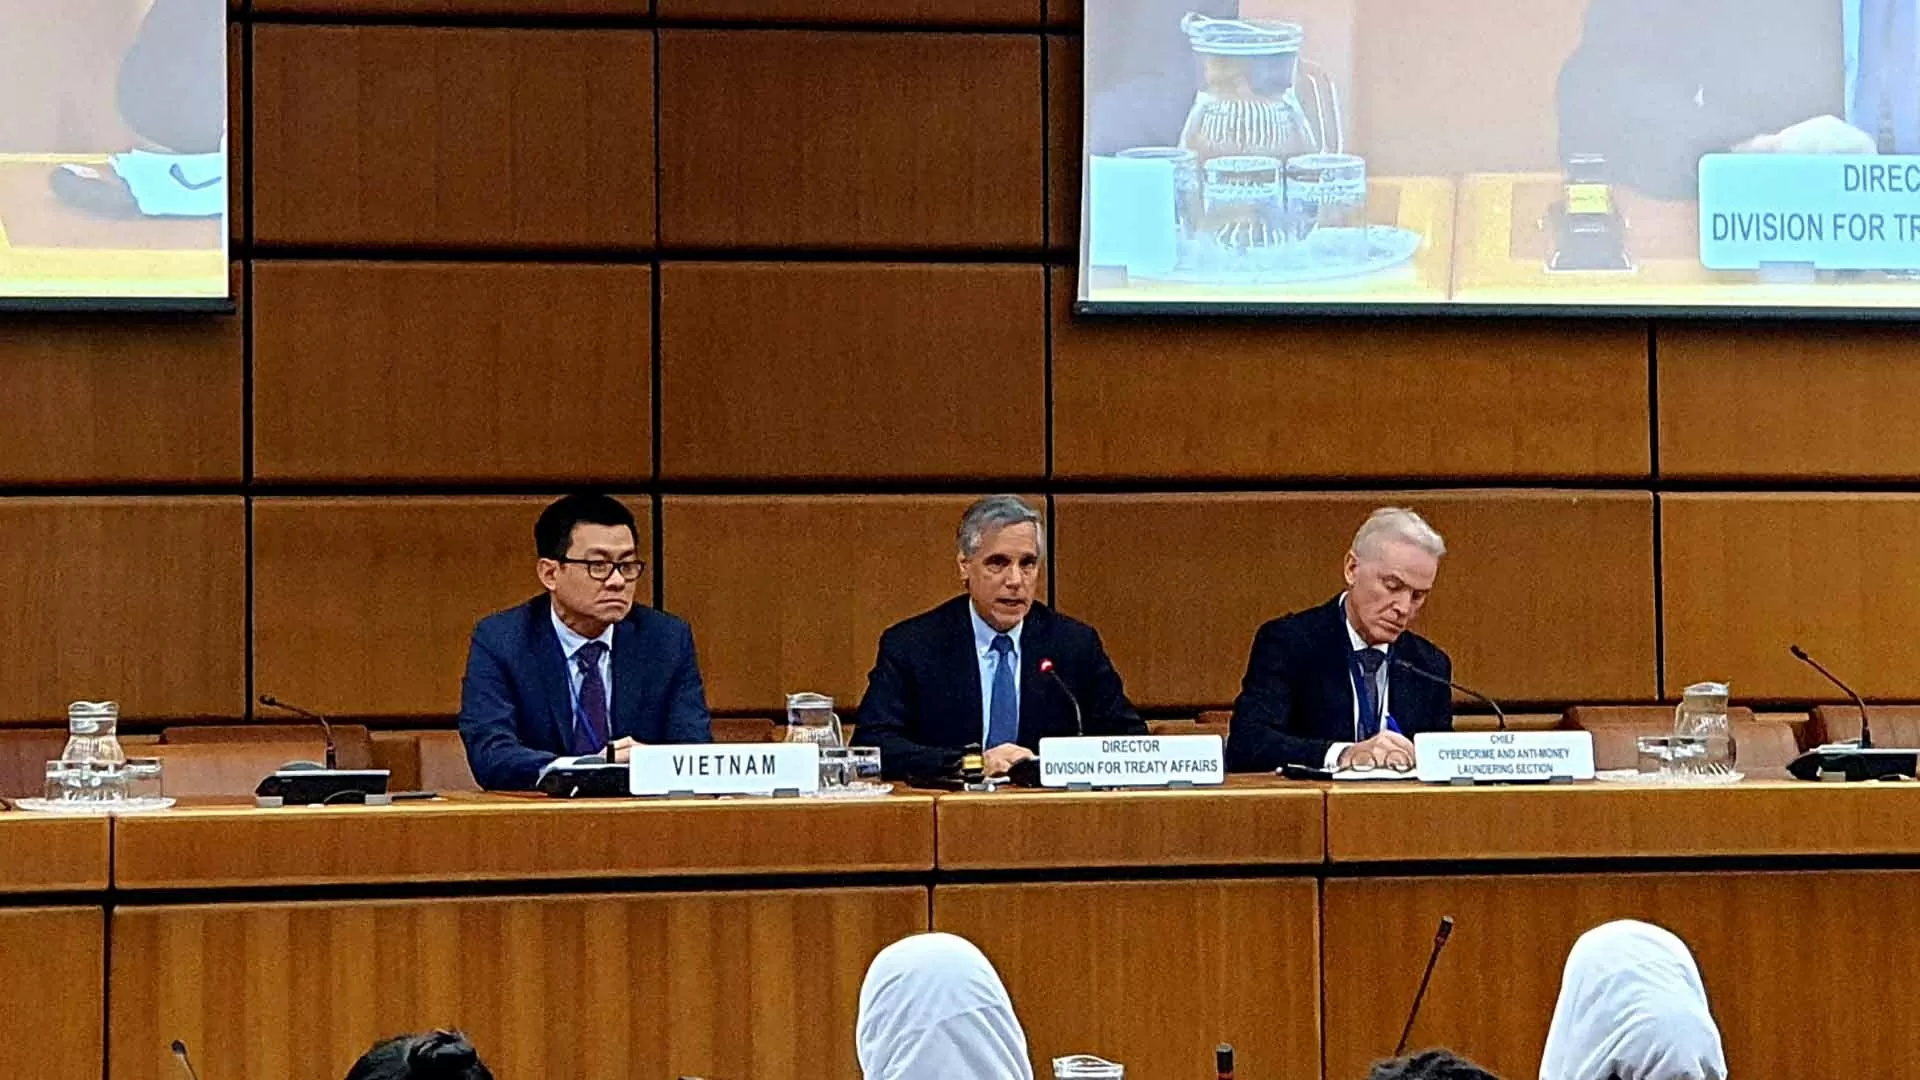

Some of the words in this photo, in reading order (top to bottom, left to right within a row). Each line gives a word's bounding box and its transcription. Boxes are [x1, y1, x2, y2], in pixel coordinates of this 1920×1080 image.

[1844, 164, 1920, 192] DIREC
[1712, 213, 1823, 241] DIVISION
[1833, 213, 1885, 241] FOR
[1102, 739, 1160, 753] DIRECTOR
[1490, 734, 1515, 745] CHIEF
[1438, 748, 1495, 760] CYBERCRIME
[1497, 748, 1515, 760] AND
[1517, 748, 1570, 760] ANTI-MONEY
[672, 754, 776, 776] VIETNAM
[1045, 760, 1094, 775] DIVISION
[1097, 760, 1123, 774] FOR
[1124, 760, 1168, 774] TREATY
[1170, 759, 1218, 773] AFFAIRS
[1458, 763, 1514, 775] LAUNDERING
[1516, 763, 1554, 774] SECTION
